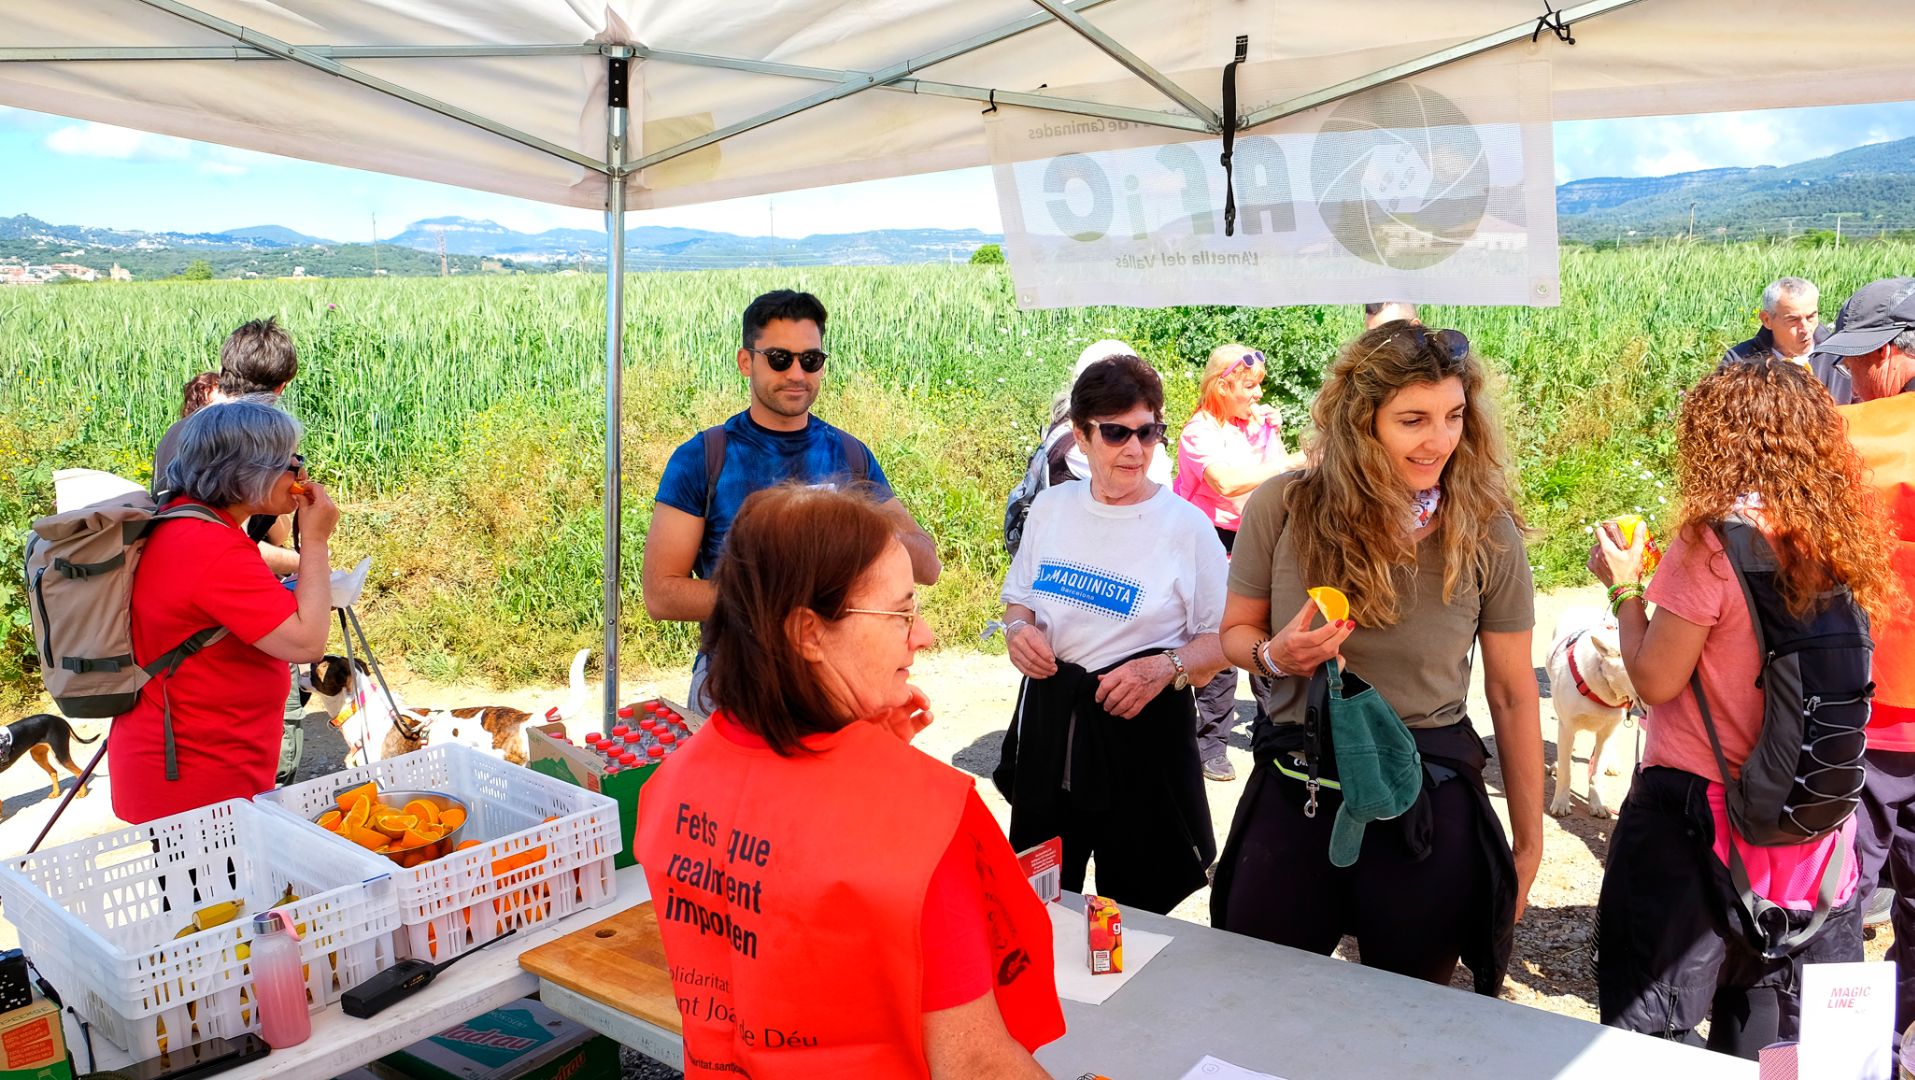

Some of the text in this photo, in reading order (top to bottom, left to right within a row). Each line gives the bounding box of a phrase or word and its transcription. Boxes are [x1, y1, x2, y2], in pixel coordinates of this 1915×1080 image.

[1060, 586, 1095, 601] Barcelona
[676, 803, 771, 868] Fets que
[667, 852, 763, 914] realment
[669, 965, 729, 992] olidaritat
[1831, 986, 1871, 998] MAGIC
[1827, 998, 1855, 1009] LINE
[677, 996, 818, 1048] nt Joa de Déu
